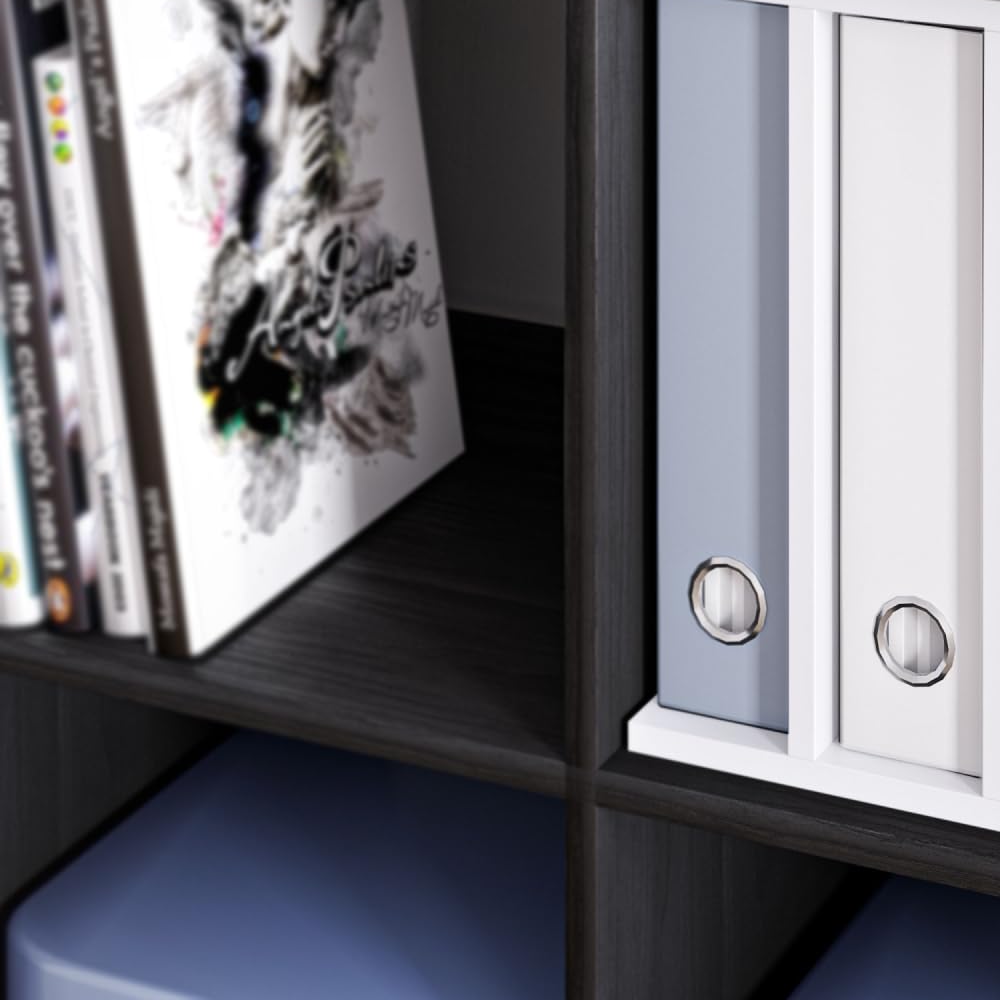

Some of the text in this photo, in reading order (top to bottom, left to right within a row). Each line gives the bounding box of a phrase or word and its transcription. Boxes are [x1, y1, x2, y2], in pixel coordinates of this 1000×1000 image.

[2, 197, 24, 272] over
[8, 282, 31, 335] the
[16, 345, 54, 489] cuckoo's
[34, 499, 65, 570] nest
